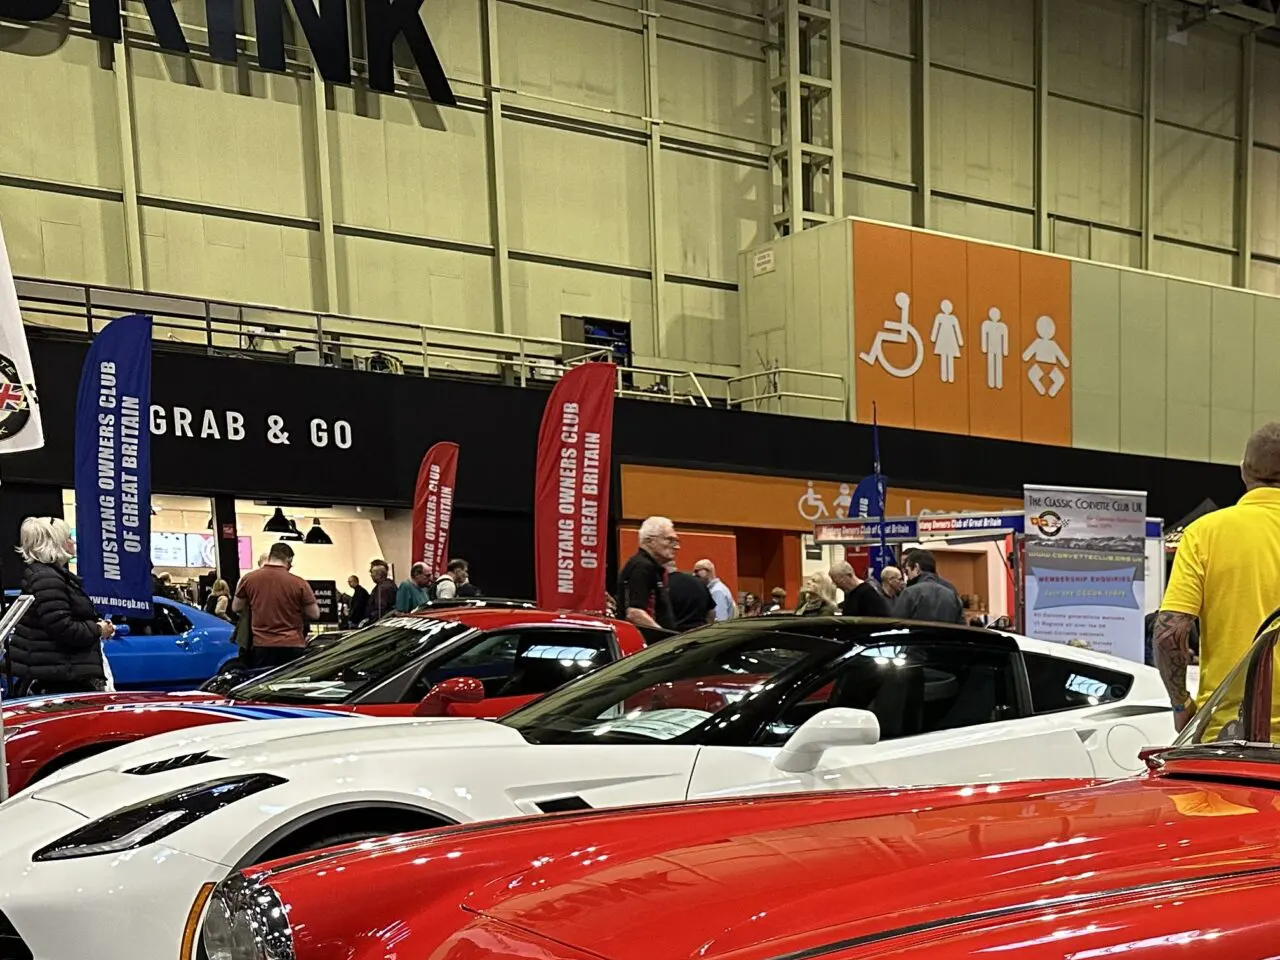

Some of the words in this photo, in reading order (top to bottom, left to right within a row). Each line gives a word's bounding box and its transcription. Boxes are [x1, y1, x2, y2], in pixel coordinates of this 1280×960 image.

[99, 361, 117, 408] CLUB
[121, 396, 139, 468] BRITAIN
[150, 405, 246, 441] GRAB
[267, 415, 290, 444] &
[310, 418, 352, 449] GO
[561, 402, 579, 443] CLUB
[98, 413, 115, 490] OWNERS
[582, 432, 600, 495] BRITAIN
[121, 472, 140, 527] GREAT
[428, 464, 440, 492] CLUB
[558, 447, 577, 515] OWNERS
[425, 495, 437, 540] OWNERS
[441, 486, 452, 529] BRITAIN
[580, 498, 598, 546] GREAT
[951, 520, 962, 528] Club
[963, 519, 968, 527] of
[969, 519, 983, 527] Great
[984, 518, 1002, 526] Britain
[1029, 496, 1041, 506] THE
[1044, 496, 1072, 509] CLASSIC
[1075, 498, 1109, 511] CORVETTE
[1112, 501, 1129, 512] CLUB
[1132, 502, 1143, 512] UK
[99, 495, 121, 580] MUSTANG
[123, 532, 142, 553] OF
[878, 524, 891, 534] Gat
[892, 523, 909, 533] Britain
[558, 519, 575, 594] MUSTANG
[581, 550, 598, 569] OF
